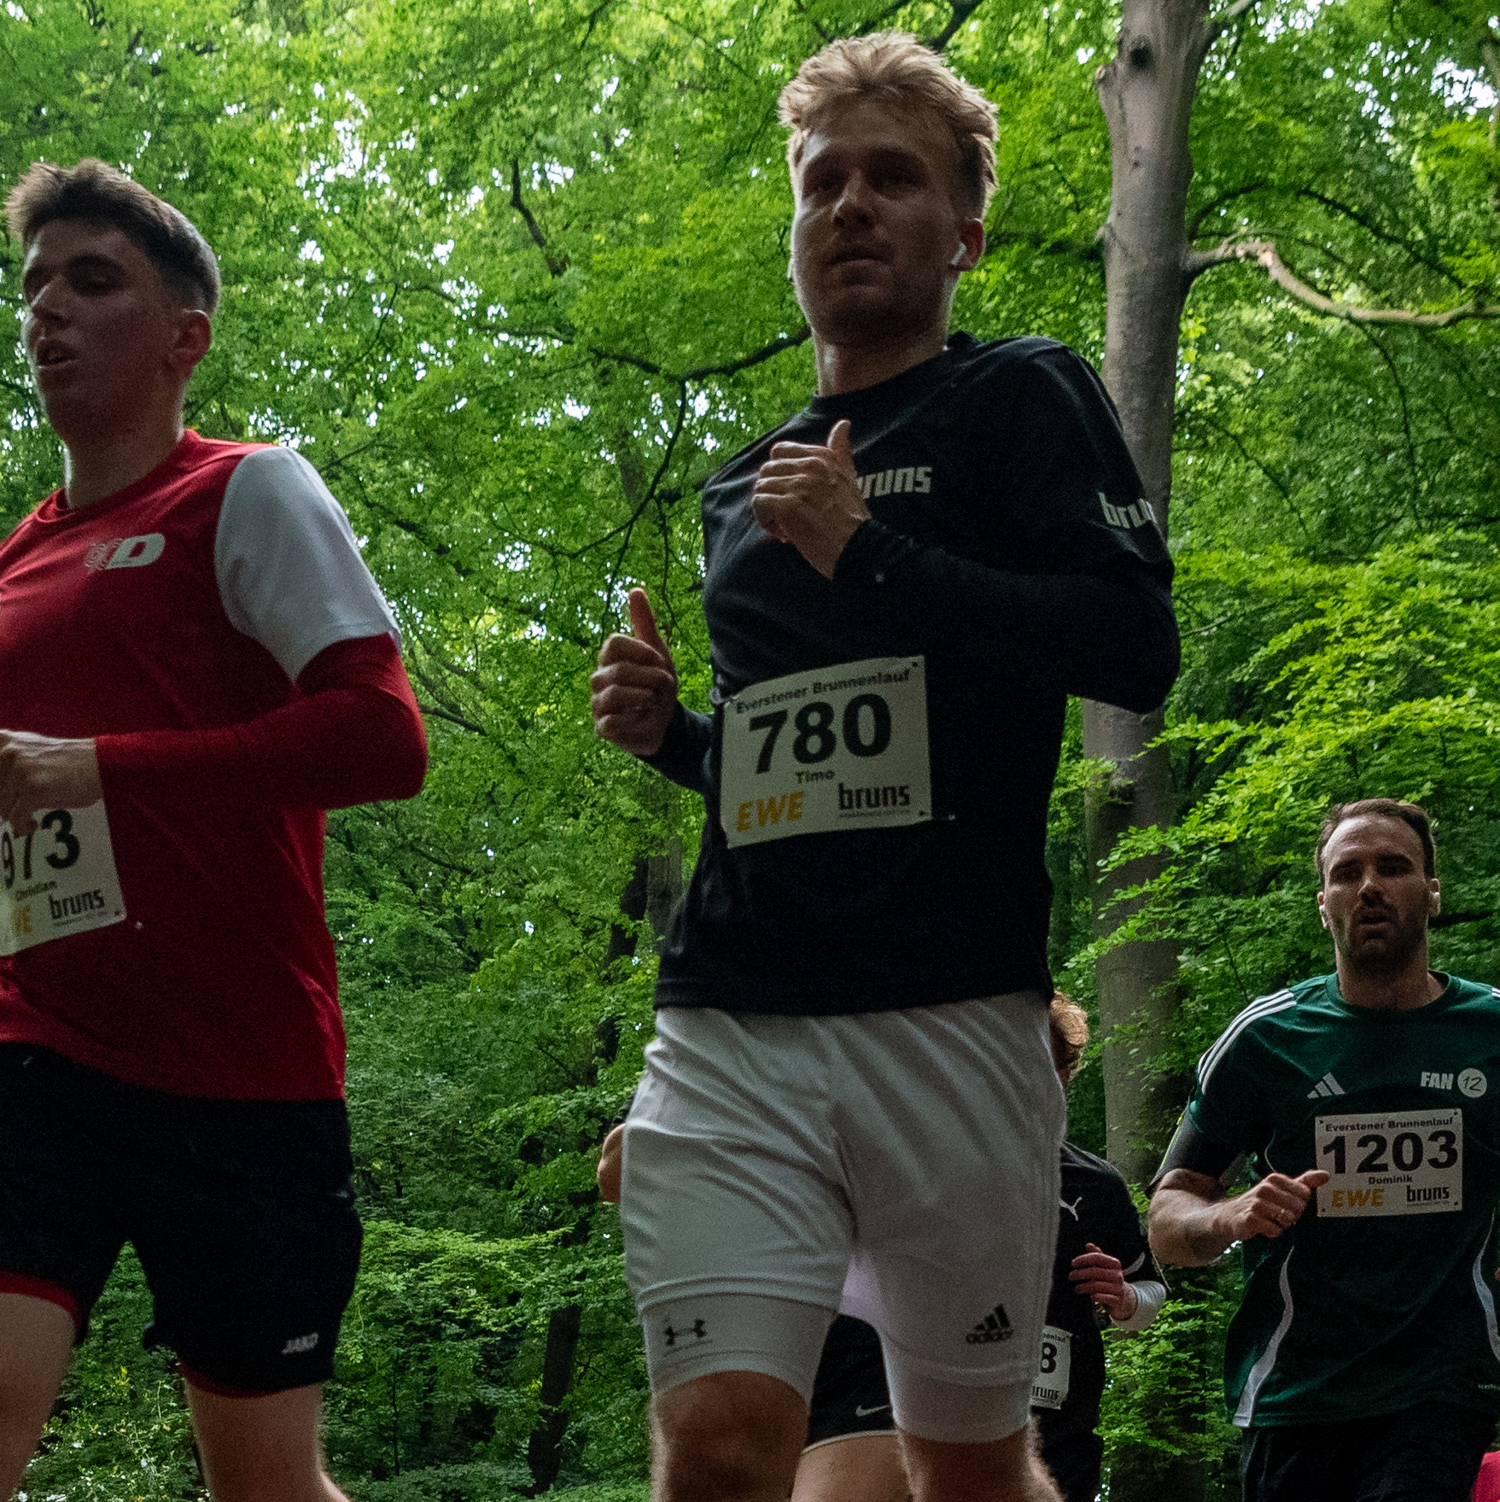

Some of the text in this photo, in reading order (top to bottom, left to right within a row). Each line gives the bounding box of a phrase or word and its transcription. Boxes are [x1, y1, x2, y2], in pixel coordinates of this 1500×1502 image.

[856, 466, 932, 499] runs
[736, 669, 911, 714] Everstener Brunnenlauf
[749, 693, 892, 774] 780
[795, 770, 835, 784] Timo
[838, 782, 911, 810] bruns
[736, 791, 804, 832] EWE
[50, 889, 105, 920] bruns
[1420, 1071, 1483, 1092] FAN 12
[1325, 1117, 1453, 1132] Everstener Brunnenlauf
[1322, 1130, 1458, 1174] 1203
[1368, 1175, 1413, 1185] Dominik
[1331, 1185, 1450, 1208] EWE bruns
